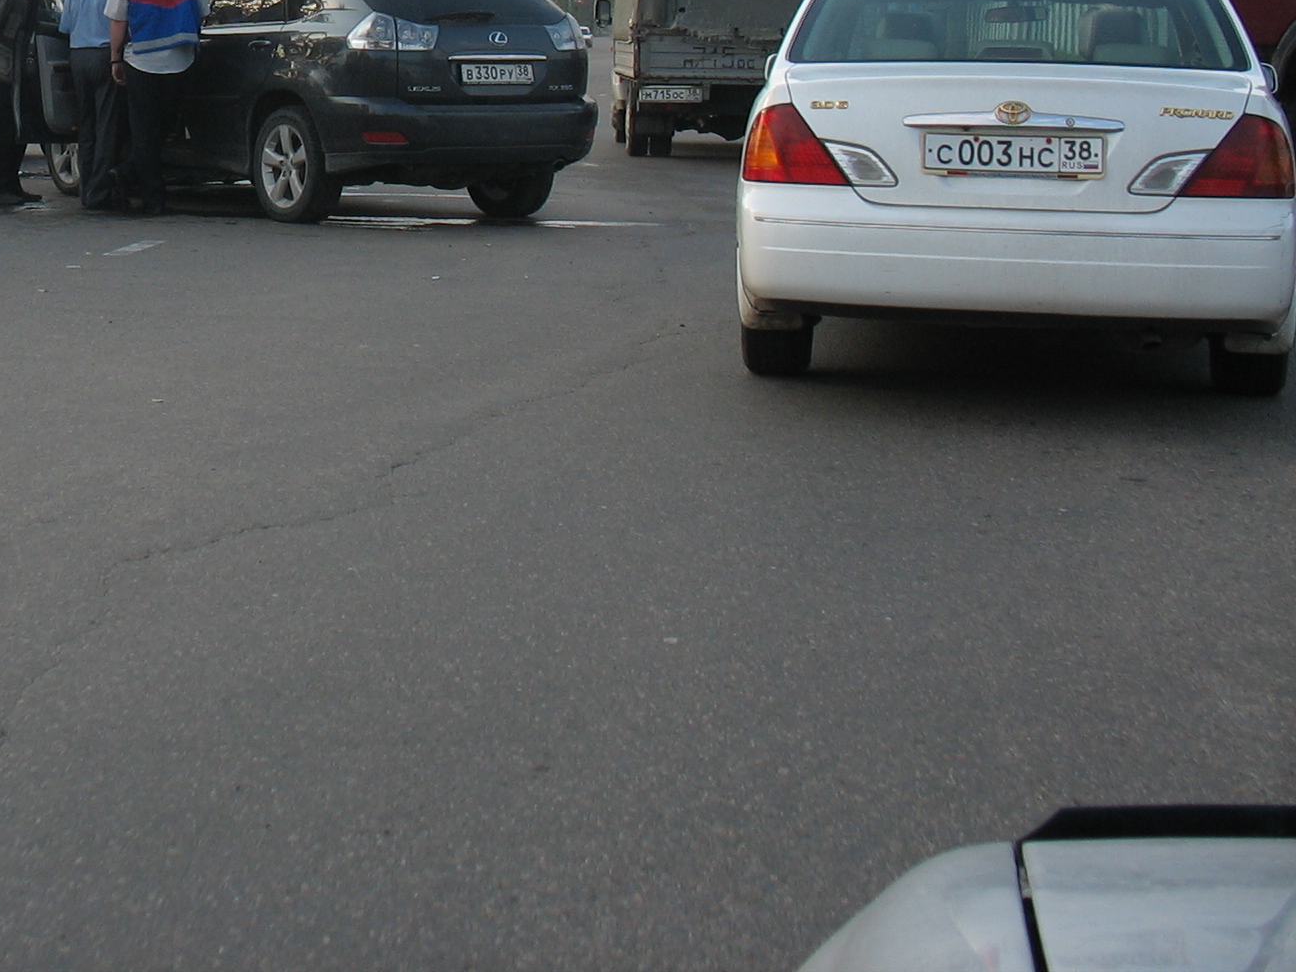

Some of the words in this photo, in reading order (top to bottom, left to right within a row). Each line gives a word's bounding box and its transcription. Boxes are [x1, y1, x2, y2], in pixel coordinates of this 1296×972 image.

[466, 65, 514, 81] В330РУ
[645, 89, 684, 100] М715ОС
[1159, 106, 1236, 120] PRONARD
[936, 139, 1054, 168] С003НС
[1063, 140, 1092, 161] 38
[1061, 161, 1083, 170] RUS
